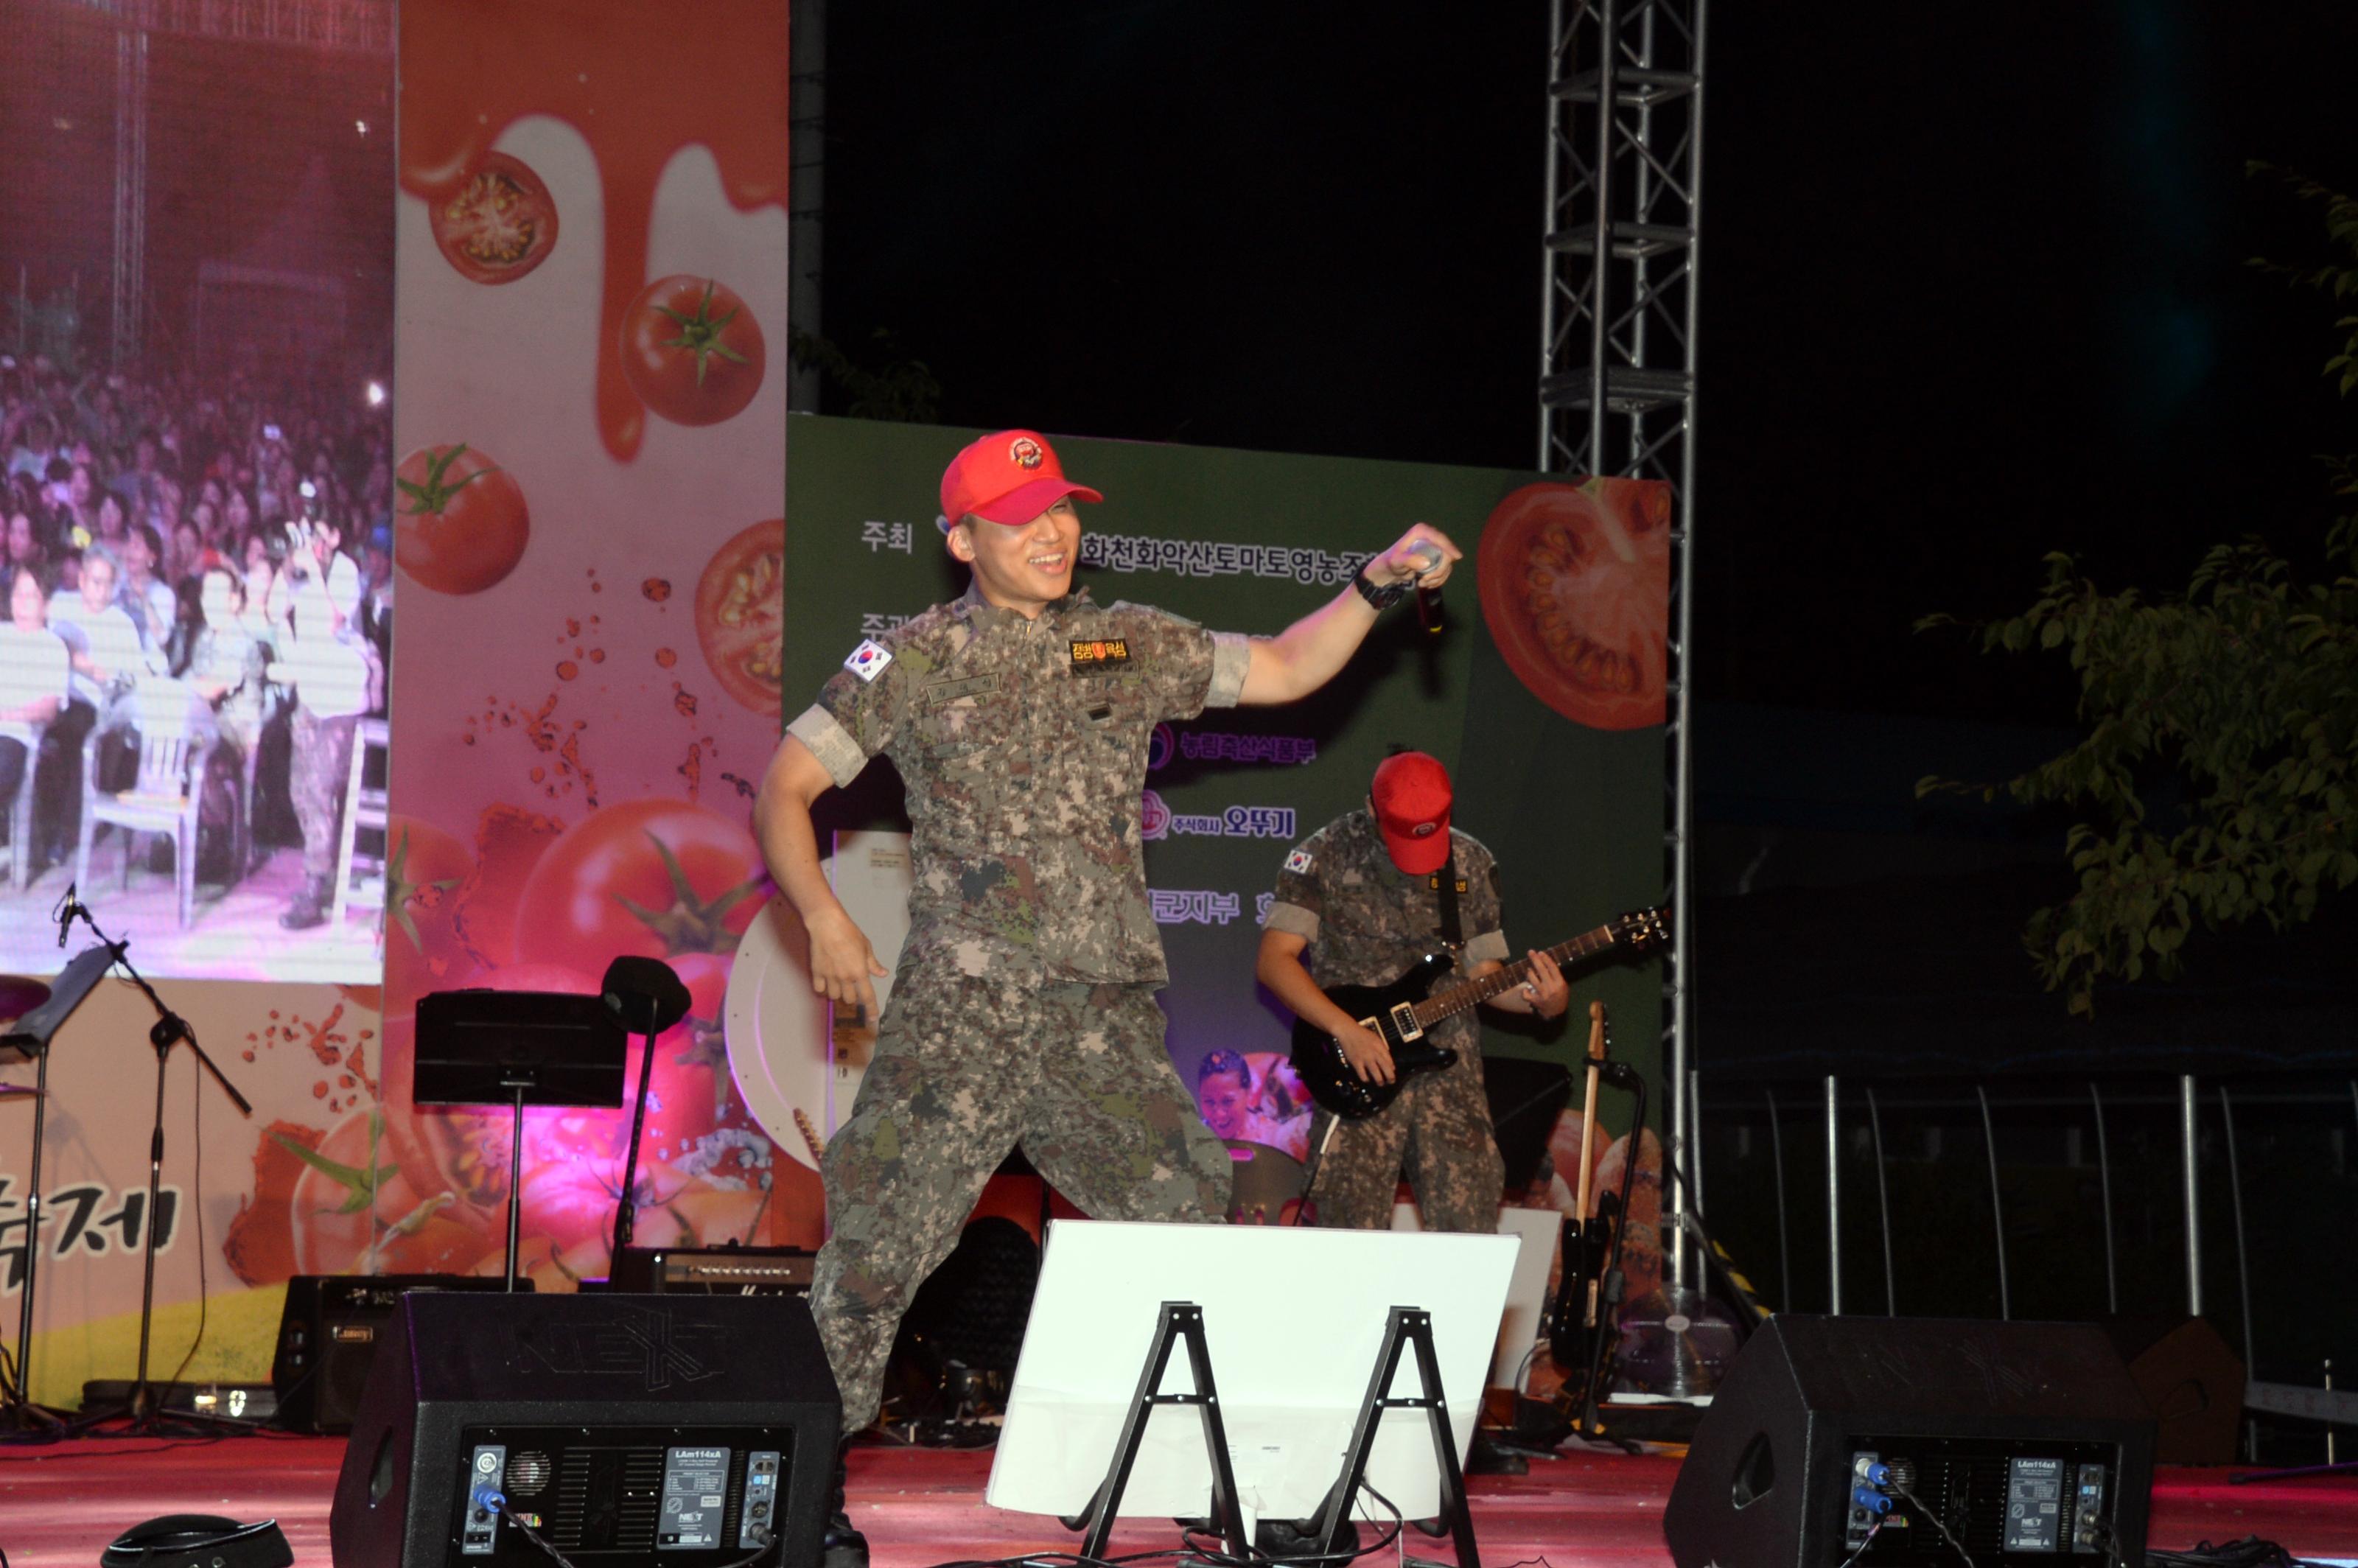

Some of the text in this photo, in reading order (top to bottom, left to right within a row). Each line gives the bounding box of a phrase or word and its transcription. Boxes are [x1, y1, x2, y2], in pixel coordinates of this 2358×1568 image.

[861, 521, 1378, 585] 주최 화천화악산토마토영농조
[1181, 732, 1316, 764] 농림축산식품부
[1172, 817, 1221, 833] 주식회사
[1225, 807, 1295, 837] 오뚜기
[1147, 889, 1240, 925] 군지부
[675, 1450, 721, 1459] LAm114xA
